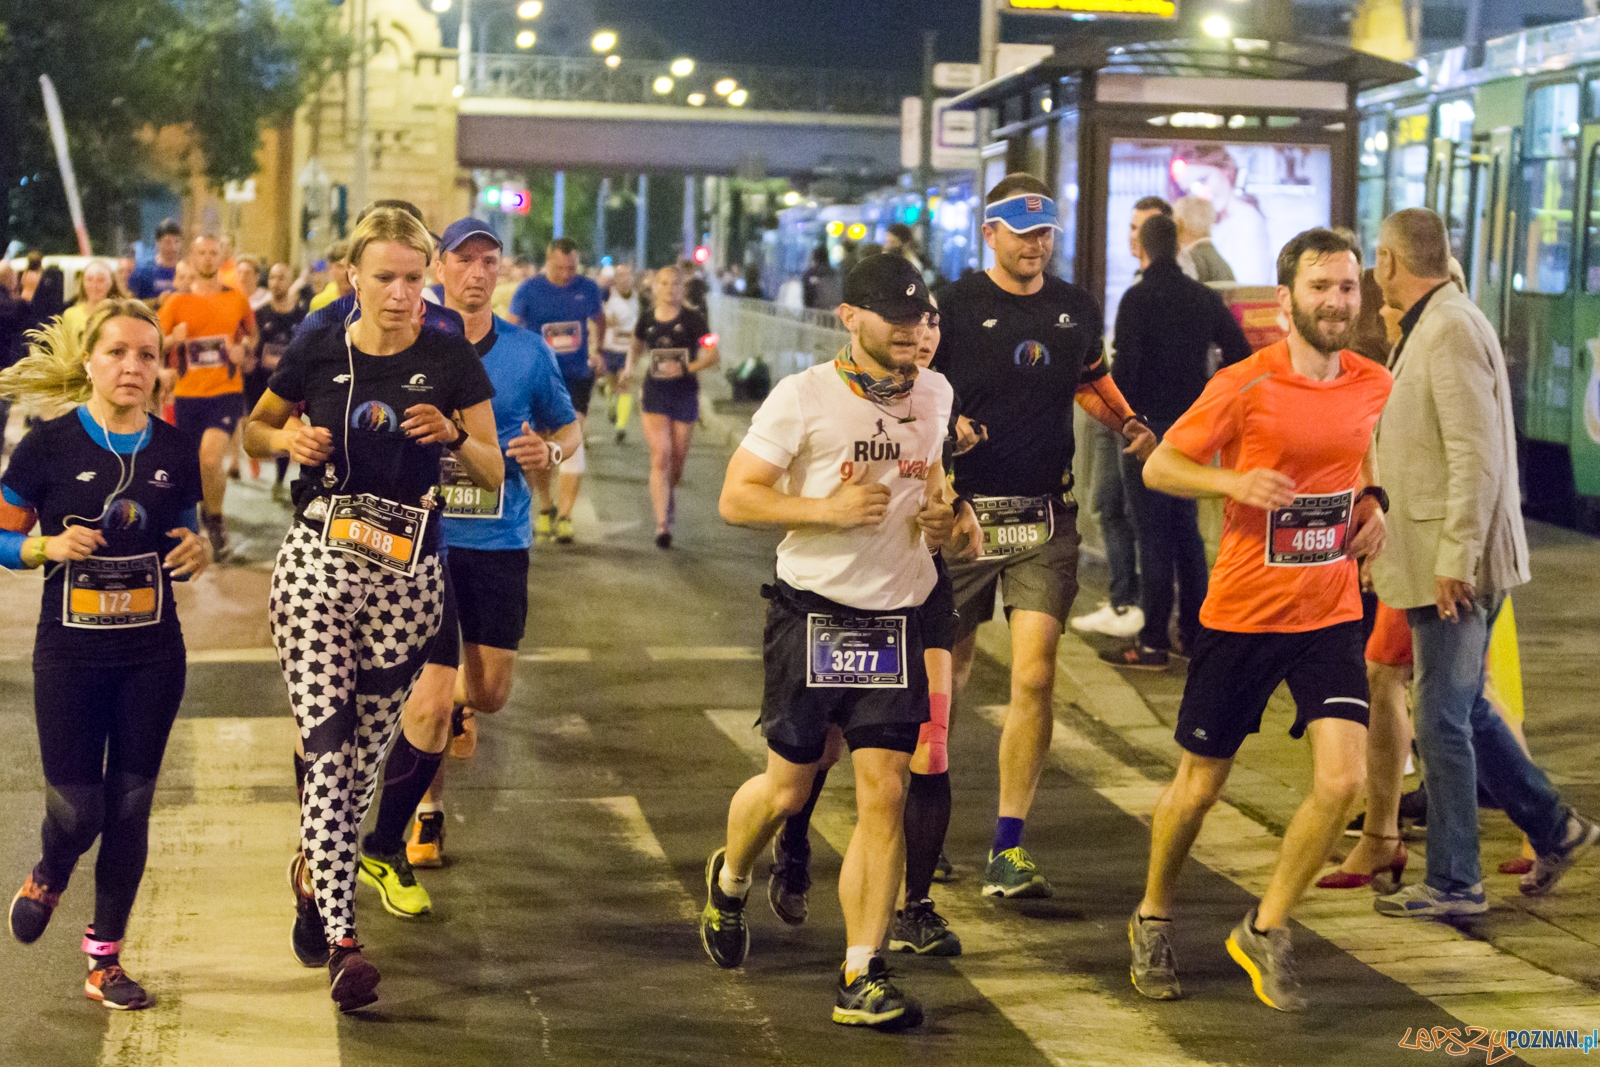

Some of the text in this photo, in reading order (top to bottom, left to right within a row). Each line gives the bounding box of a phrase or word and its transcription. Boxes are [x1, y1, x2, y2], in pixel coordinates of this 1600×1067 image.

[853, 440, 901, 462] RUN
[444, 487, 481, 505] 7361
[348, 521, 394, 554] 6788
[997, 524, 1038, 545] 8085
[1292, 527, 1336, 551] 4659
[98, 592, 132, 613] 172
[831, 650, 879, 672] 3277
